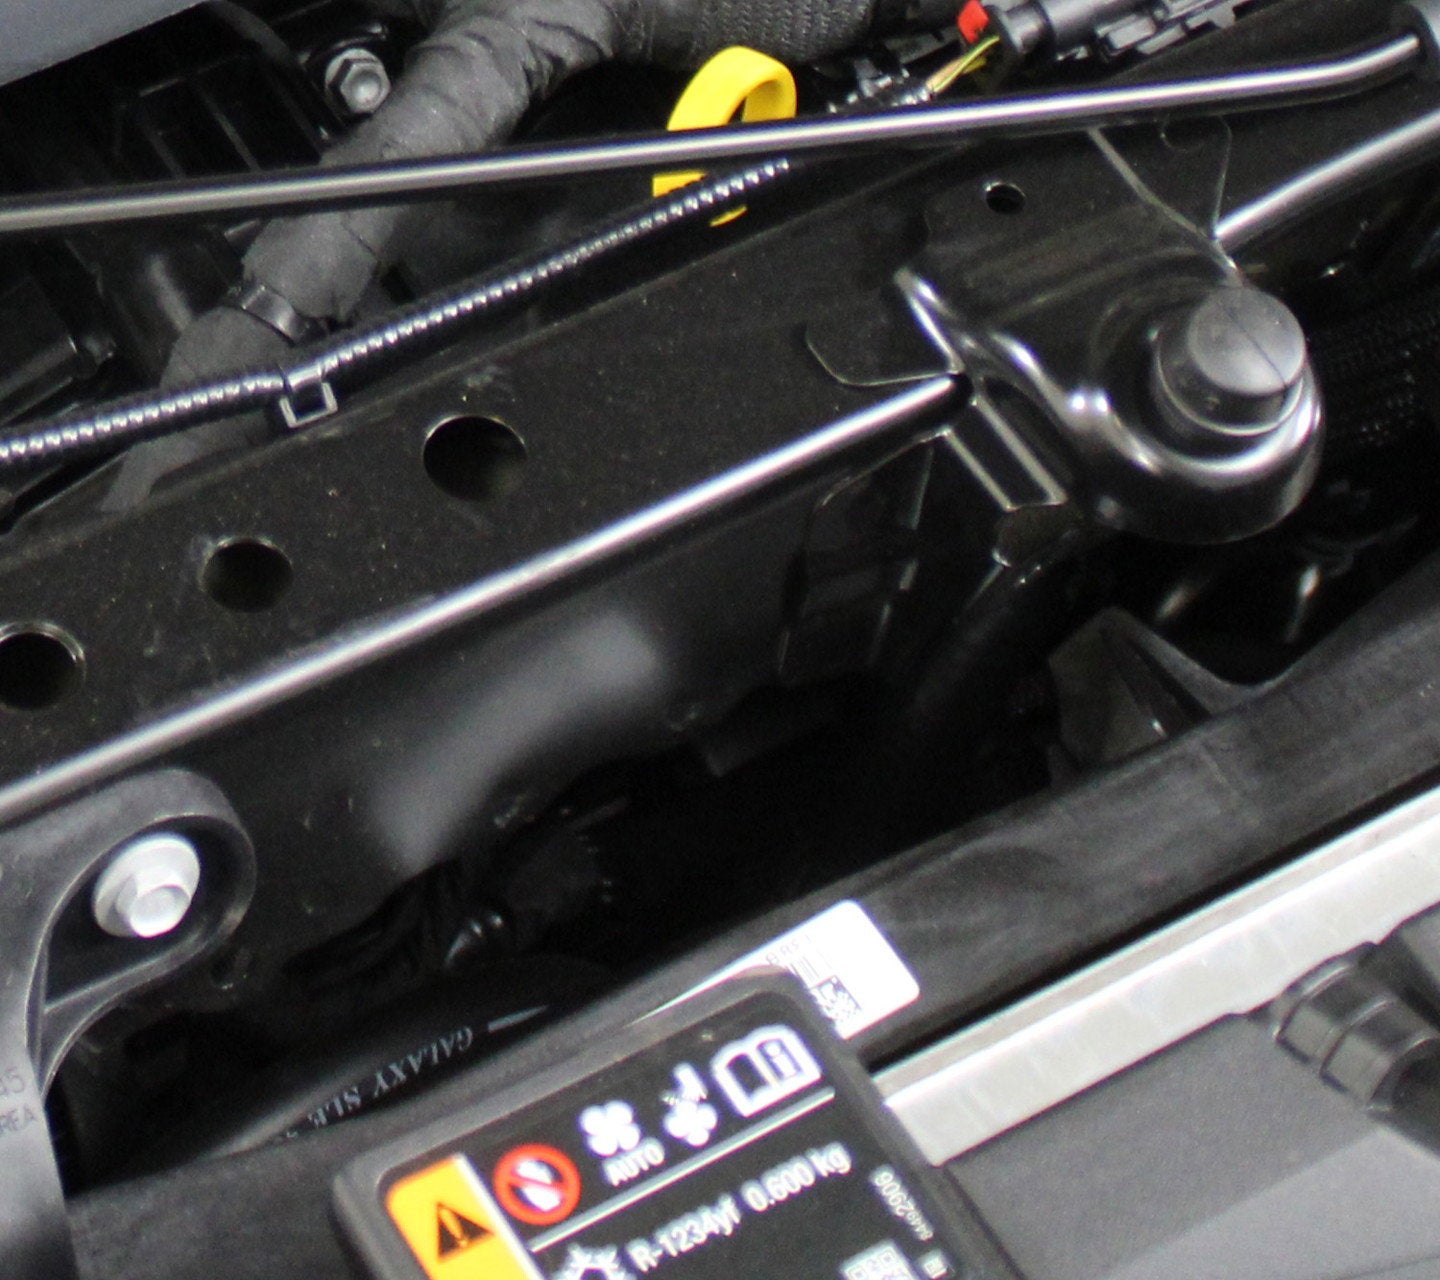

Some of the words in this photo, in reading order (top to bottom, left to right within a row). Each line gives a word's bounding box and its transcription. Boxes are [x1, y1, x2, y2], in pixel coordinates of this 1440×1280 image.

[373, 1026, 473, 1098] GALAXY
[604, 1137, 665, 1186] AUTO
[628, 1195, 741, 1272] R-1234yf
[742, 1157, 815, 1212] 0.600
[811, 1142, 852, 1176] kg
